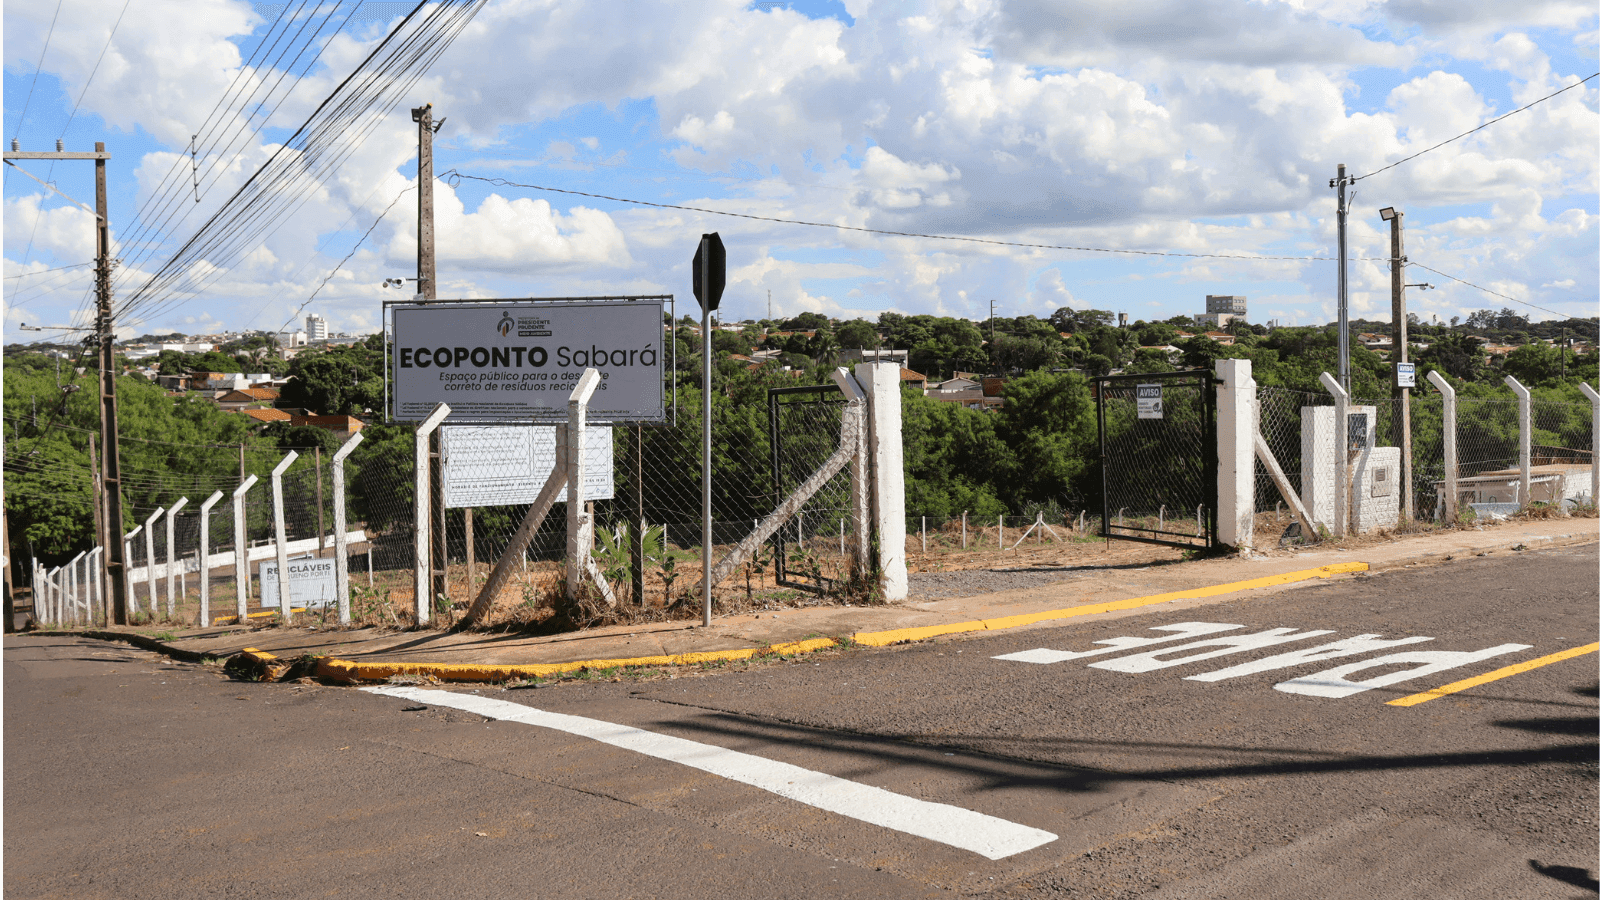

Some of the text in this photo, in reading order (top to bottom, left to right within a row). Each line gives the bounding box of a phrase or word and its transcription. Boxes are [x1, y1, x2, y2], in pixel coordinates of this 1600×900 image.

[400, 344, 657, 368] ECOPONTO Sabará
[440, 372, 477, 383] Espaço
[479, 371, 519, 383] público
[521, 373, 548, 383] para
[561, 371, 609, 381] deste
[444, 383, 482, 391] correto
[484, 382, 498, 391] de
[501, 381, 546, 391] resíduos
[1140, 388, 1160, 397] AVISO
[267, 563, 331, 575] REICLÁVEIS
[990, 621, 1533, 698] PARE
